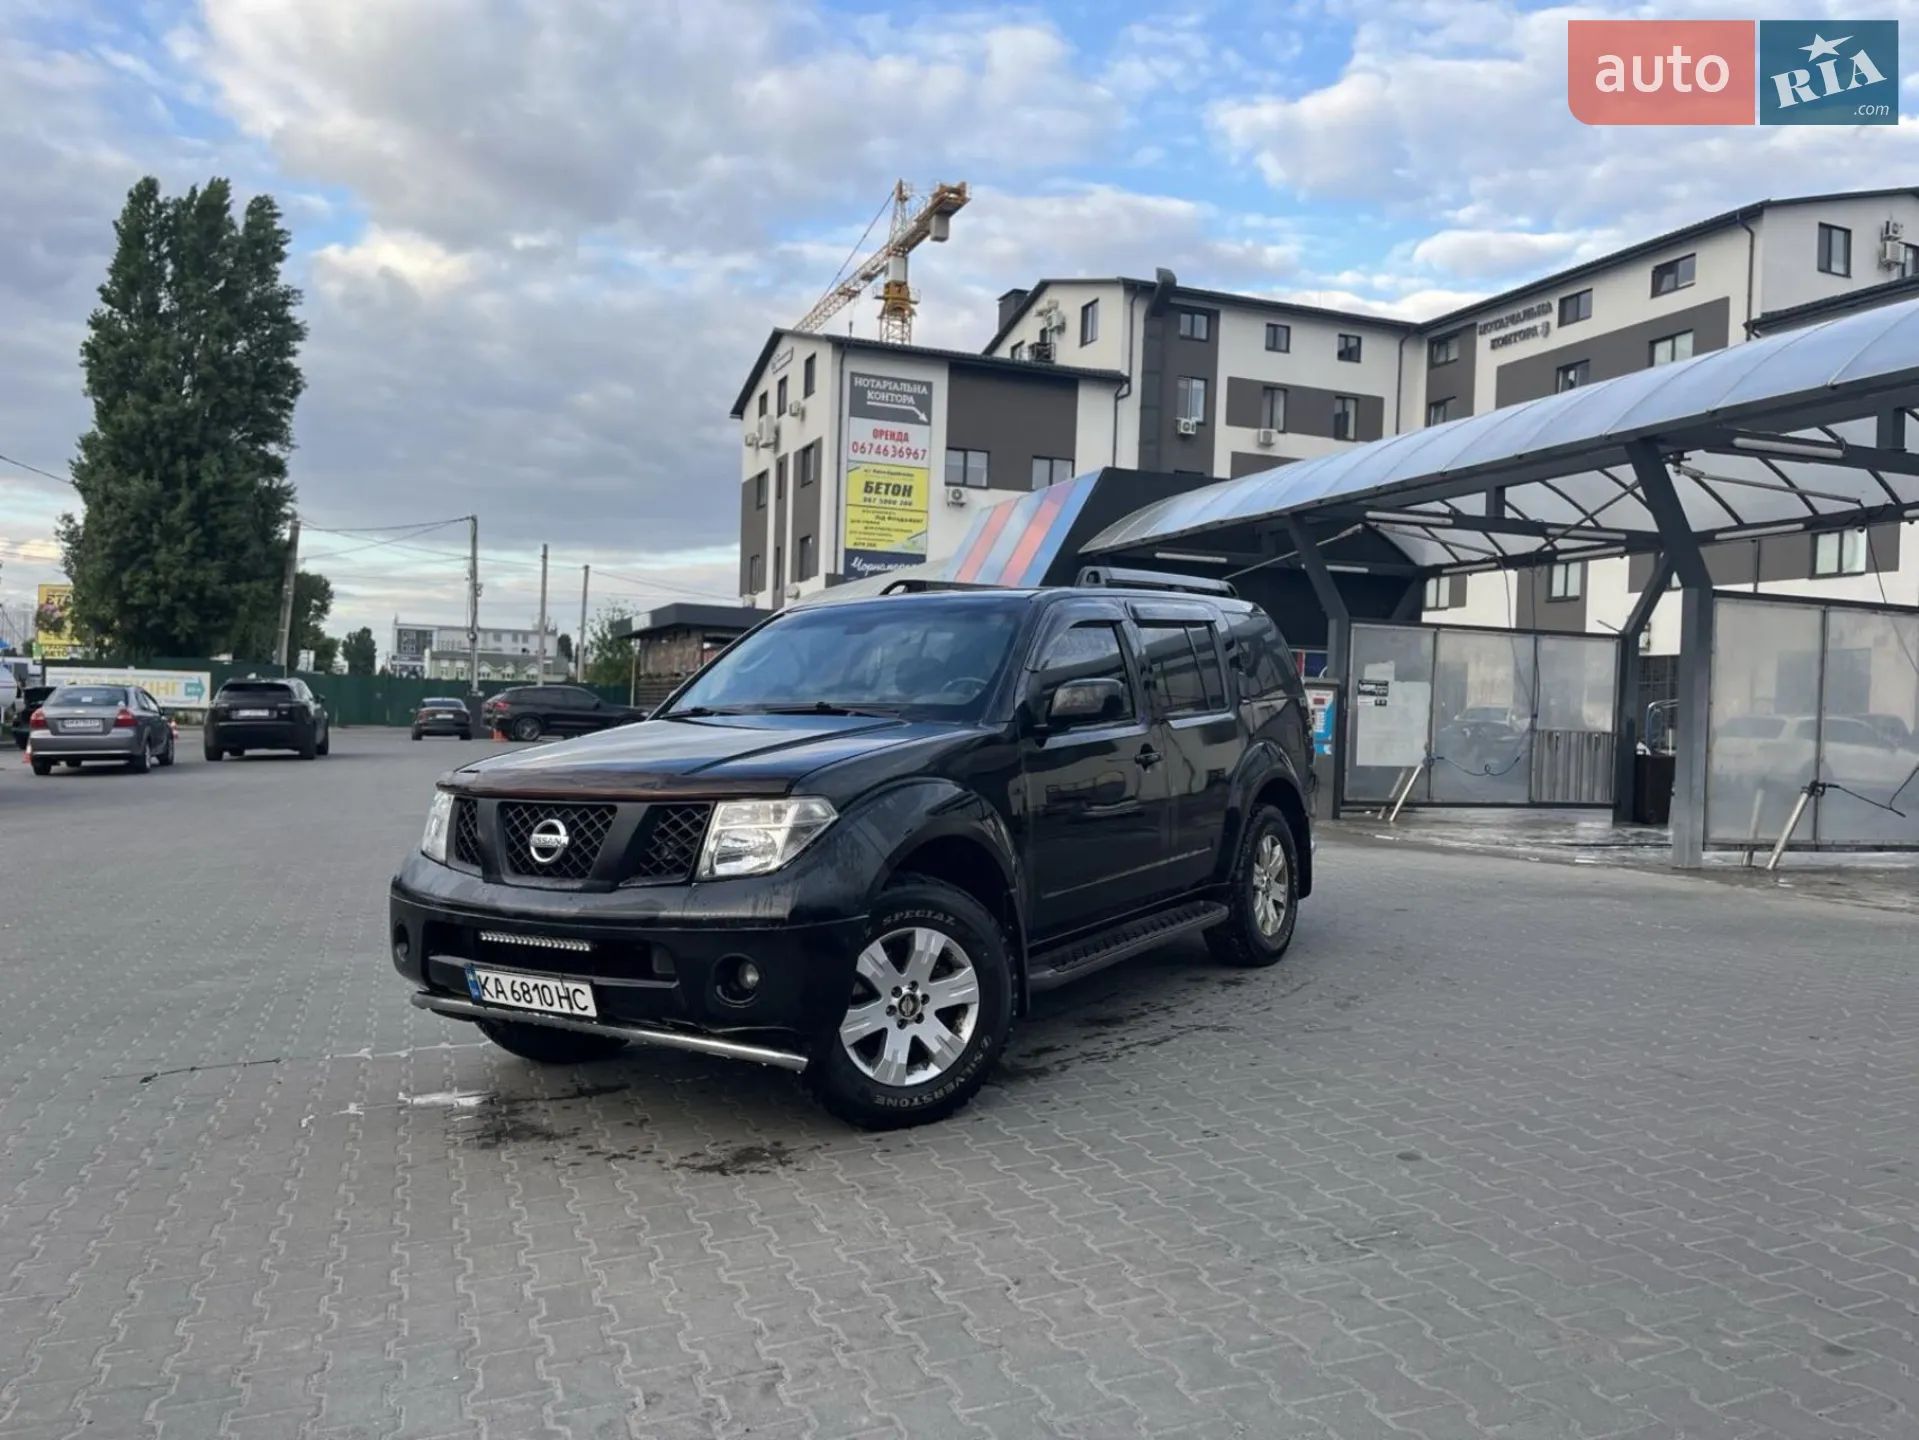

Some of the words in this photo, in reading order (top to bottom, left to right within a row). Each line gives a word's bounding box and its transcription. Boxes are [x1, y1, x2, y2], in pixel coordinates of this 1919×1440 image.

[853, 376, 929, 395] НОТАРІАЛЬНА
[866, 390, 916, 405] КОНТОРА
[872, 427, 910, 443] ОРЕНДА
[851, 440, 928, 461] 0674636967
[863, 480, 914, 498] БЕТОН
[882, 908, 956, 926] SPECIAL
